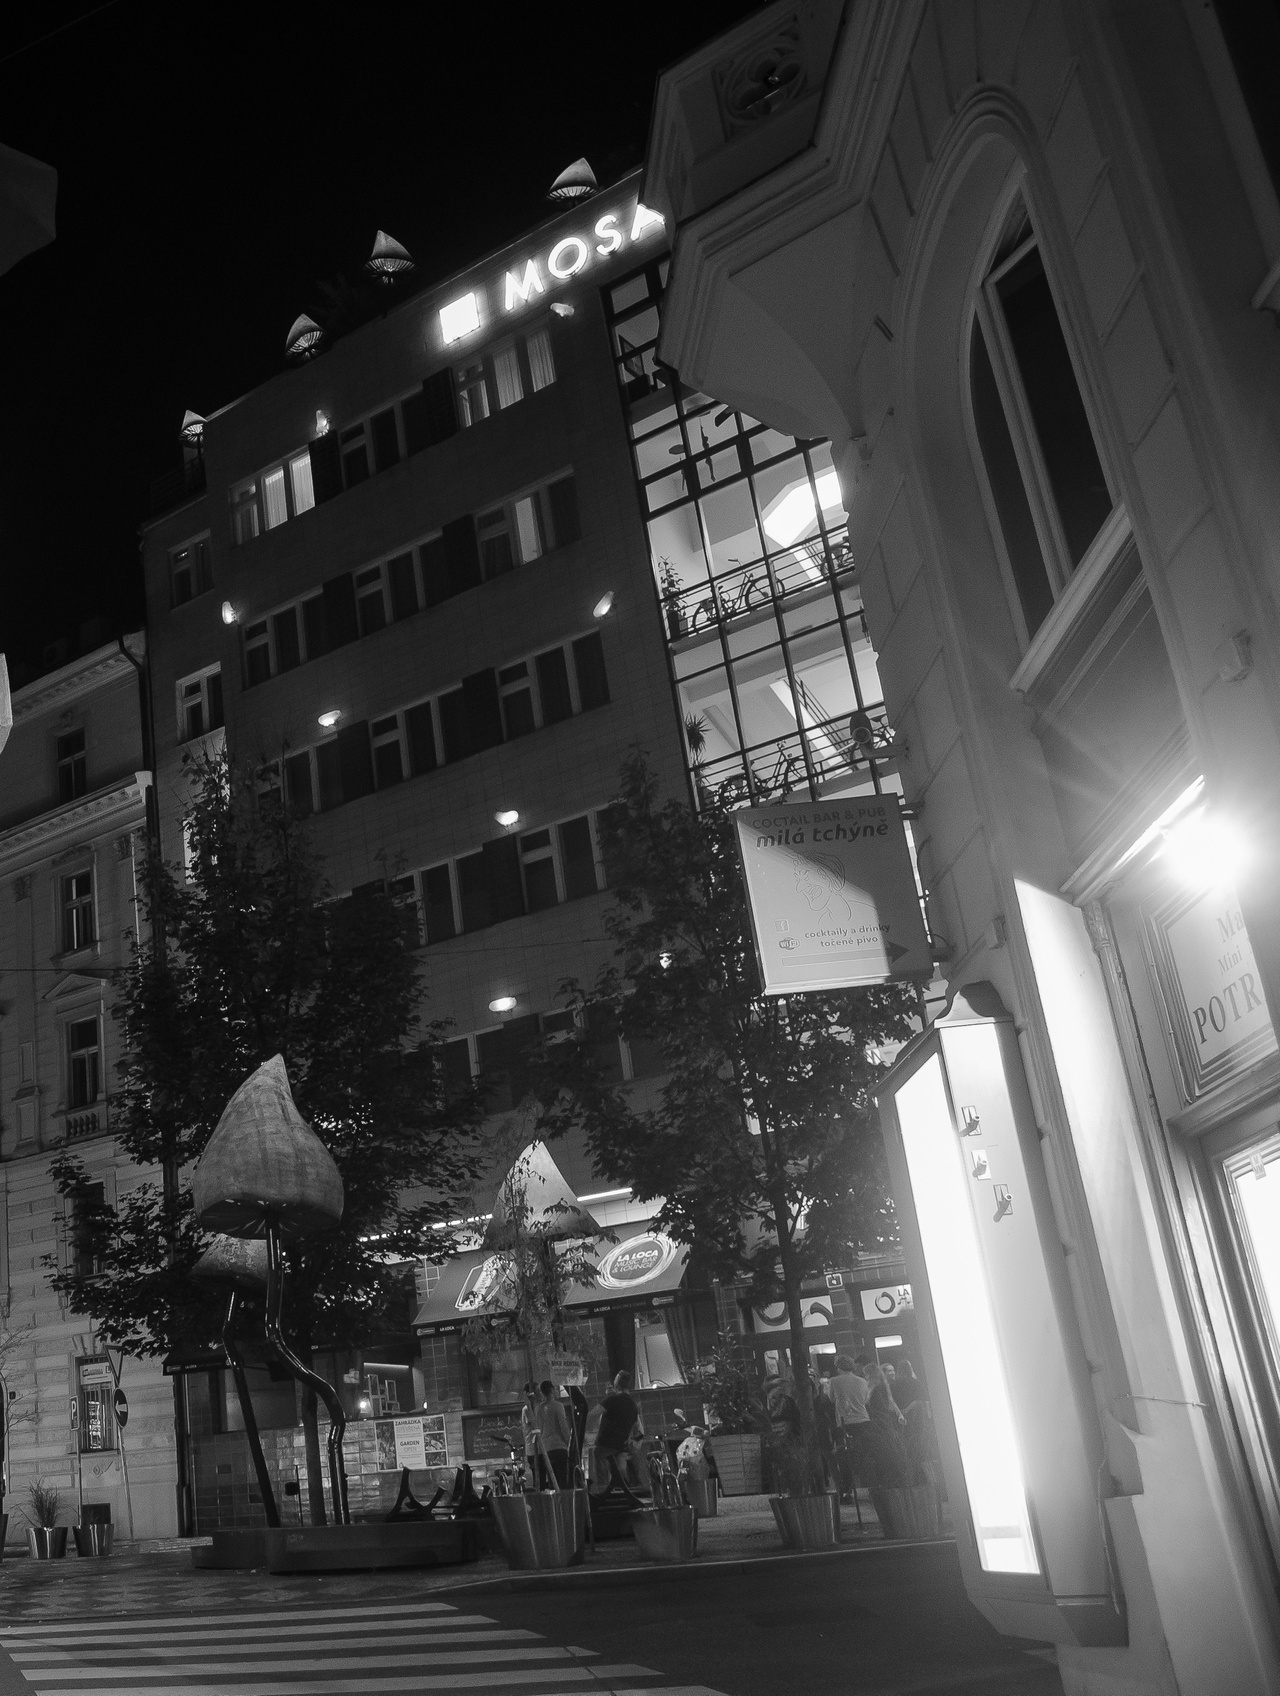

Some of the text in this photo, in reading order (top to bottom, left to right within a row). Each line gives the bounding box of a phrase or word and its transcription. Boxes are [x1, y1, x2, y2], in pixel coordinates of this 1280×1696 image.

[752, 806, 886, 830] COCTAIL BAR & PUB
[756, 818, 889, 848] milá tchýně
[804, 927, 848, 939] cocktaily
[859, 923, 890, 933] drinky
[820, 935, 879, 948] točené pivo
[1217, 945, 1243, 975] Mini
[1192, 972, 1263, 1045] POTR
[614, 1256, 658, 1268] MUSIC BAR
[617, 1249, 659, 1262] LA LOCA
[619, 1262, 655, 1273] LOUNGE
[897, 1288, 910, 1297] LA
